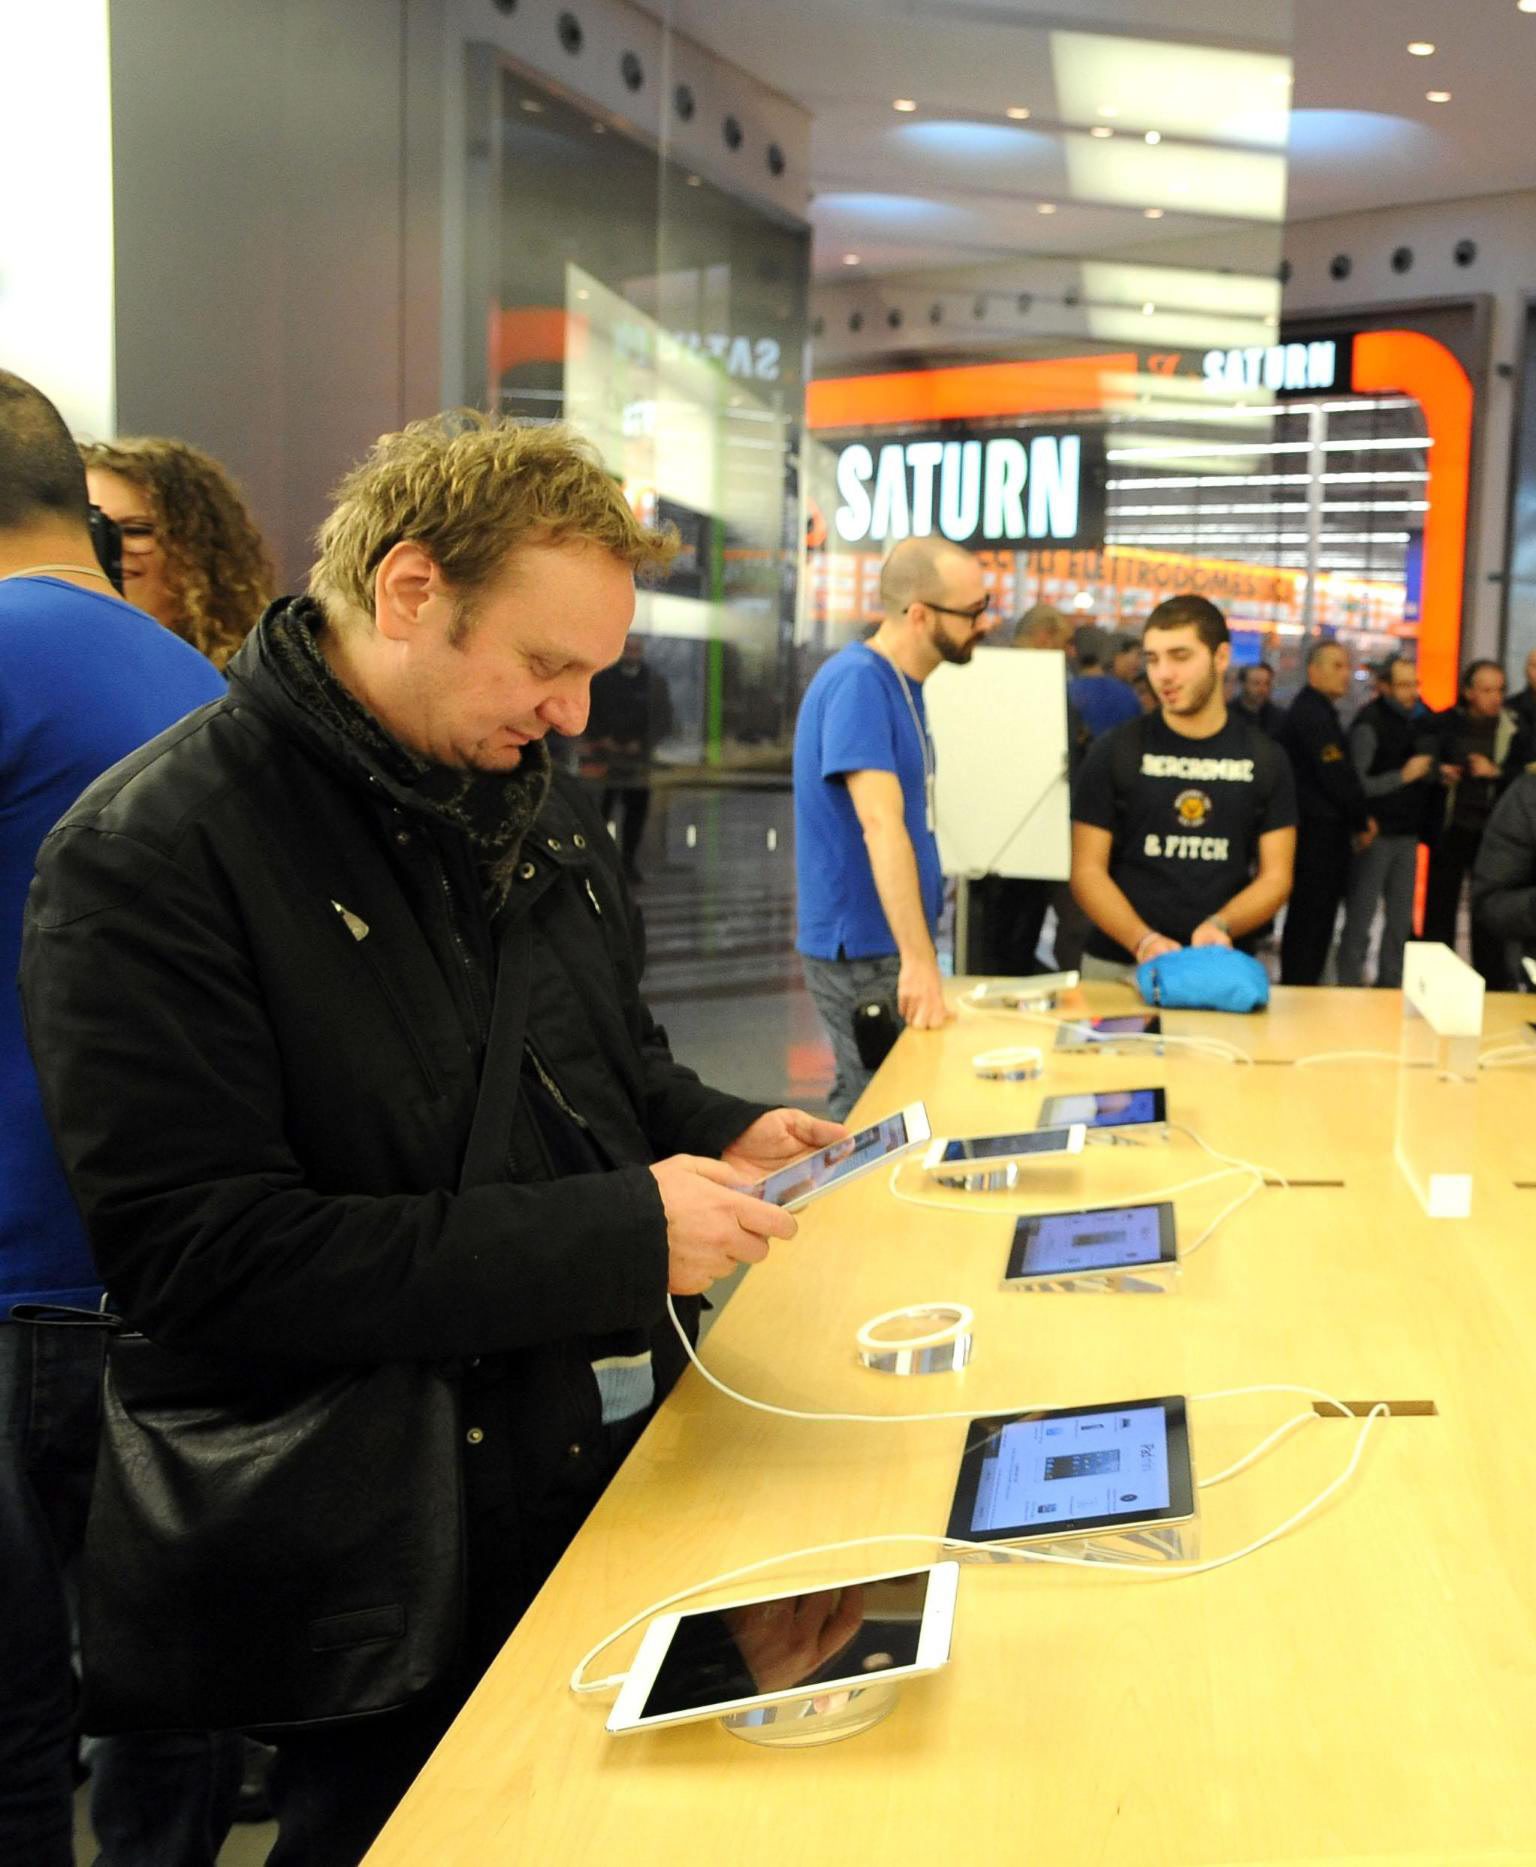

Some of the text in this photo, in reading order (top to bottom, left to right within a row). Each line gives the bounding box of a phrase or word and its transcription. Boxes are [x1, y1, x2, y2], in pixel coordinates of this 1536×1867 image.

[1202, 340, 1336, 393] SATURN
[834, 434, 1081, 541] SATURN
[1144, 834, 1230, 862] & FITCH
